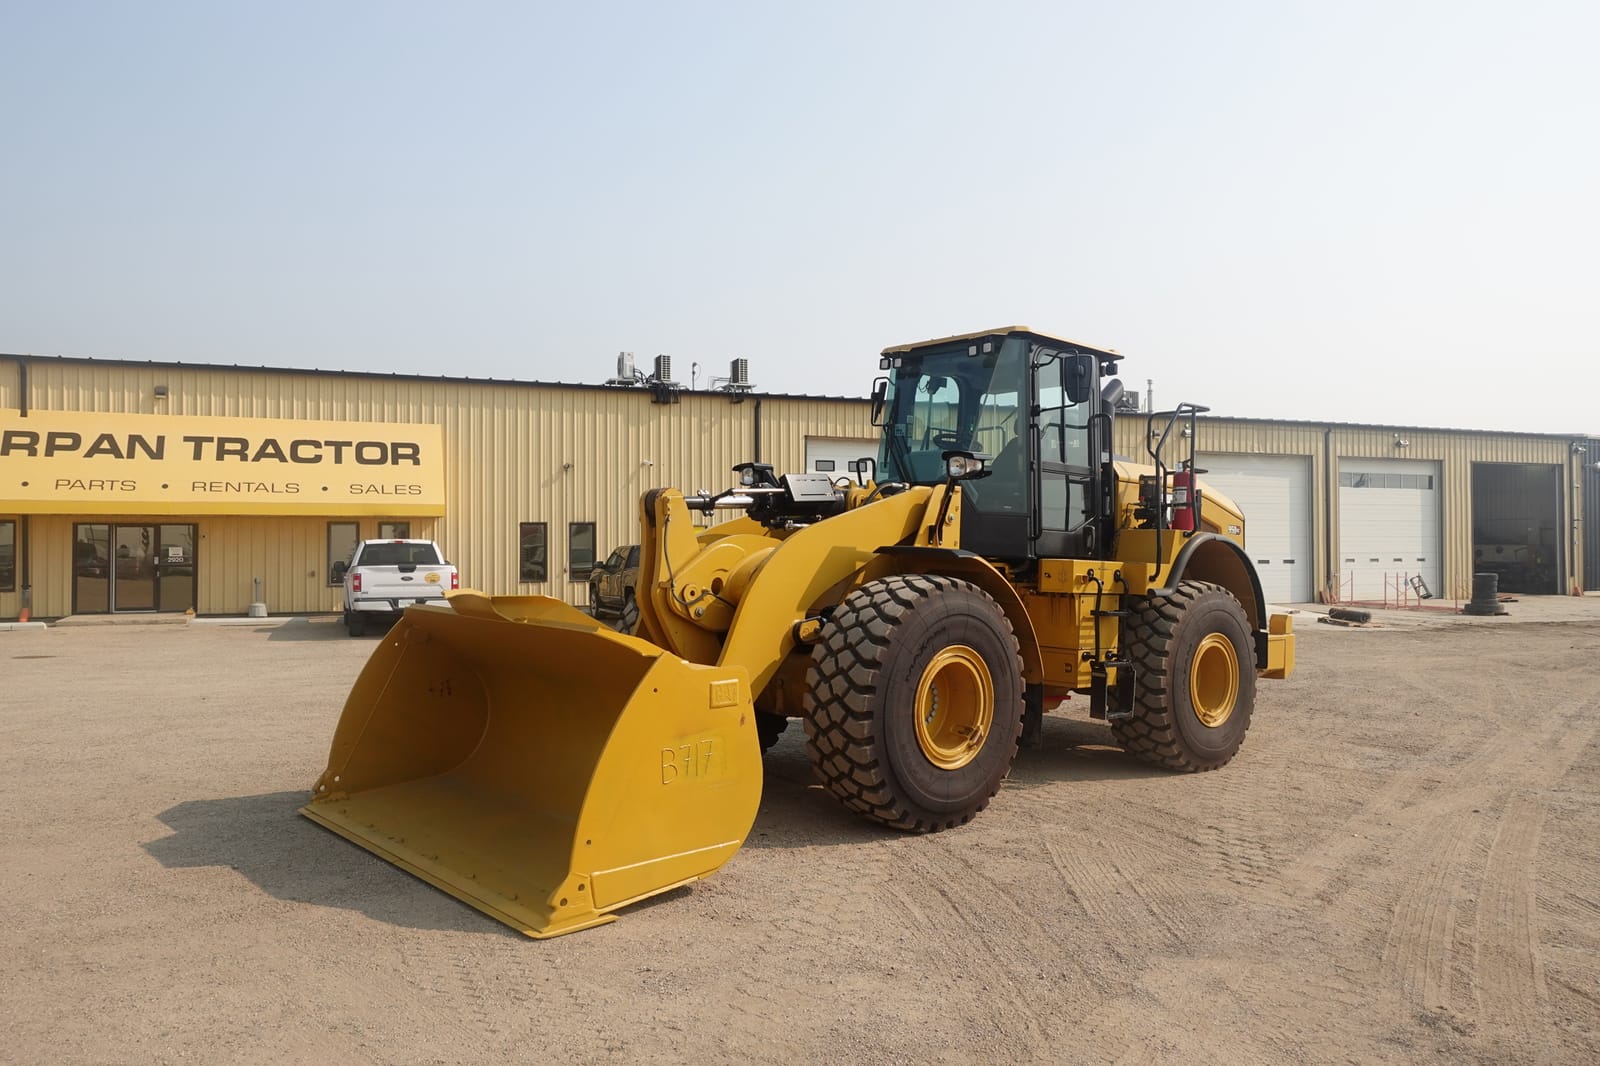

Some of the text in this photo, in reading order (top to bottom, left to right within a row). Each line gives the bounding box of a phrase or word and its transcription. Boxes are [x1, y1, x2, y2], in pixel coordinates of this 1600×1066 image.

[0, 430, 421, 466] RPAN TRACTOR
[54, 479, 422, 496] PARTS RENTALS SALES
